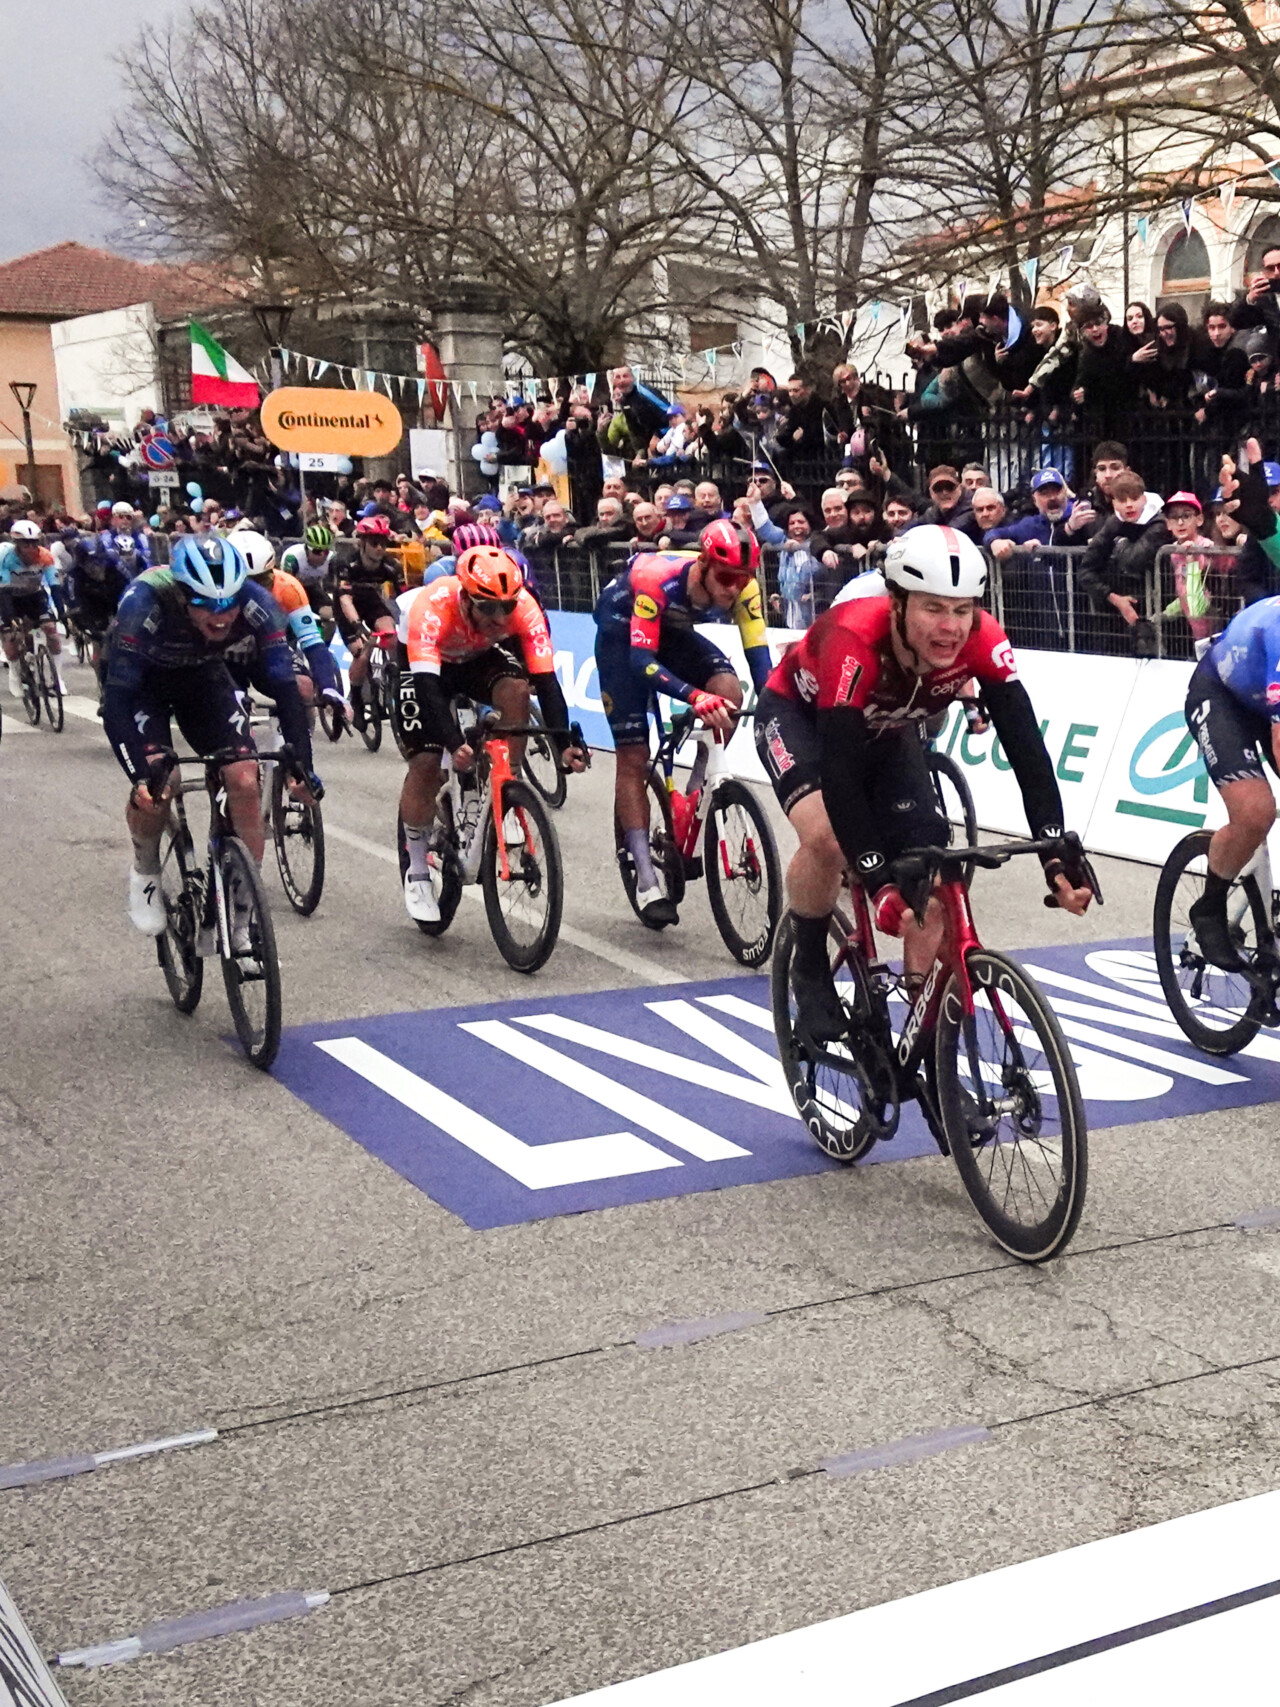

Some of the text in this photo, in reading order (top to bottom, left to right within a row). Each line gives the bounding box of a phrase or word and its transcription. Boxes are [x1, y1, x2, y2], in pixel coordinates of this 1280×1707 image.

[277, 409, 370, 430] Continental
[308, 457, 325, 468] 25
[400, 671, 422, 731] INEOS
[898, 958, 943, 1066] ORBEA
